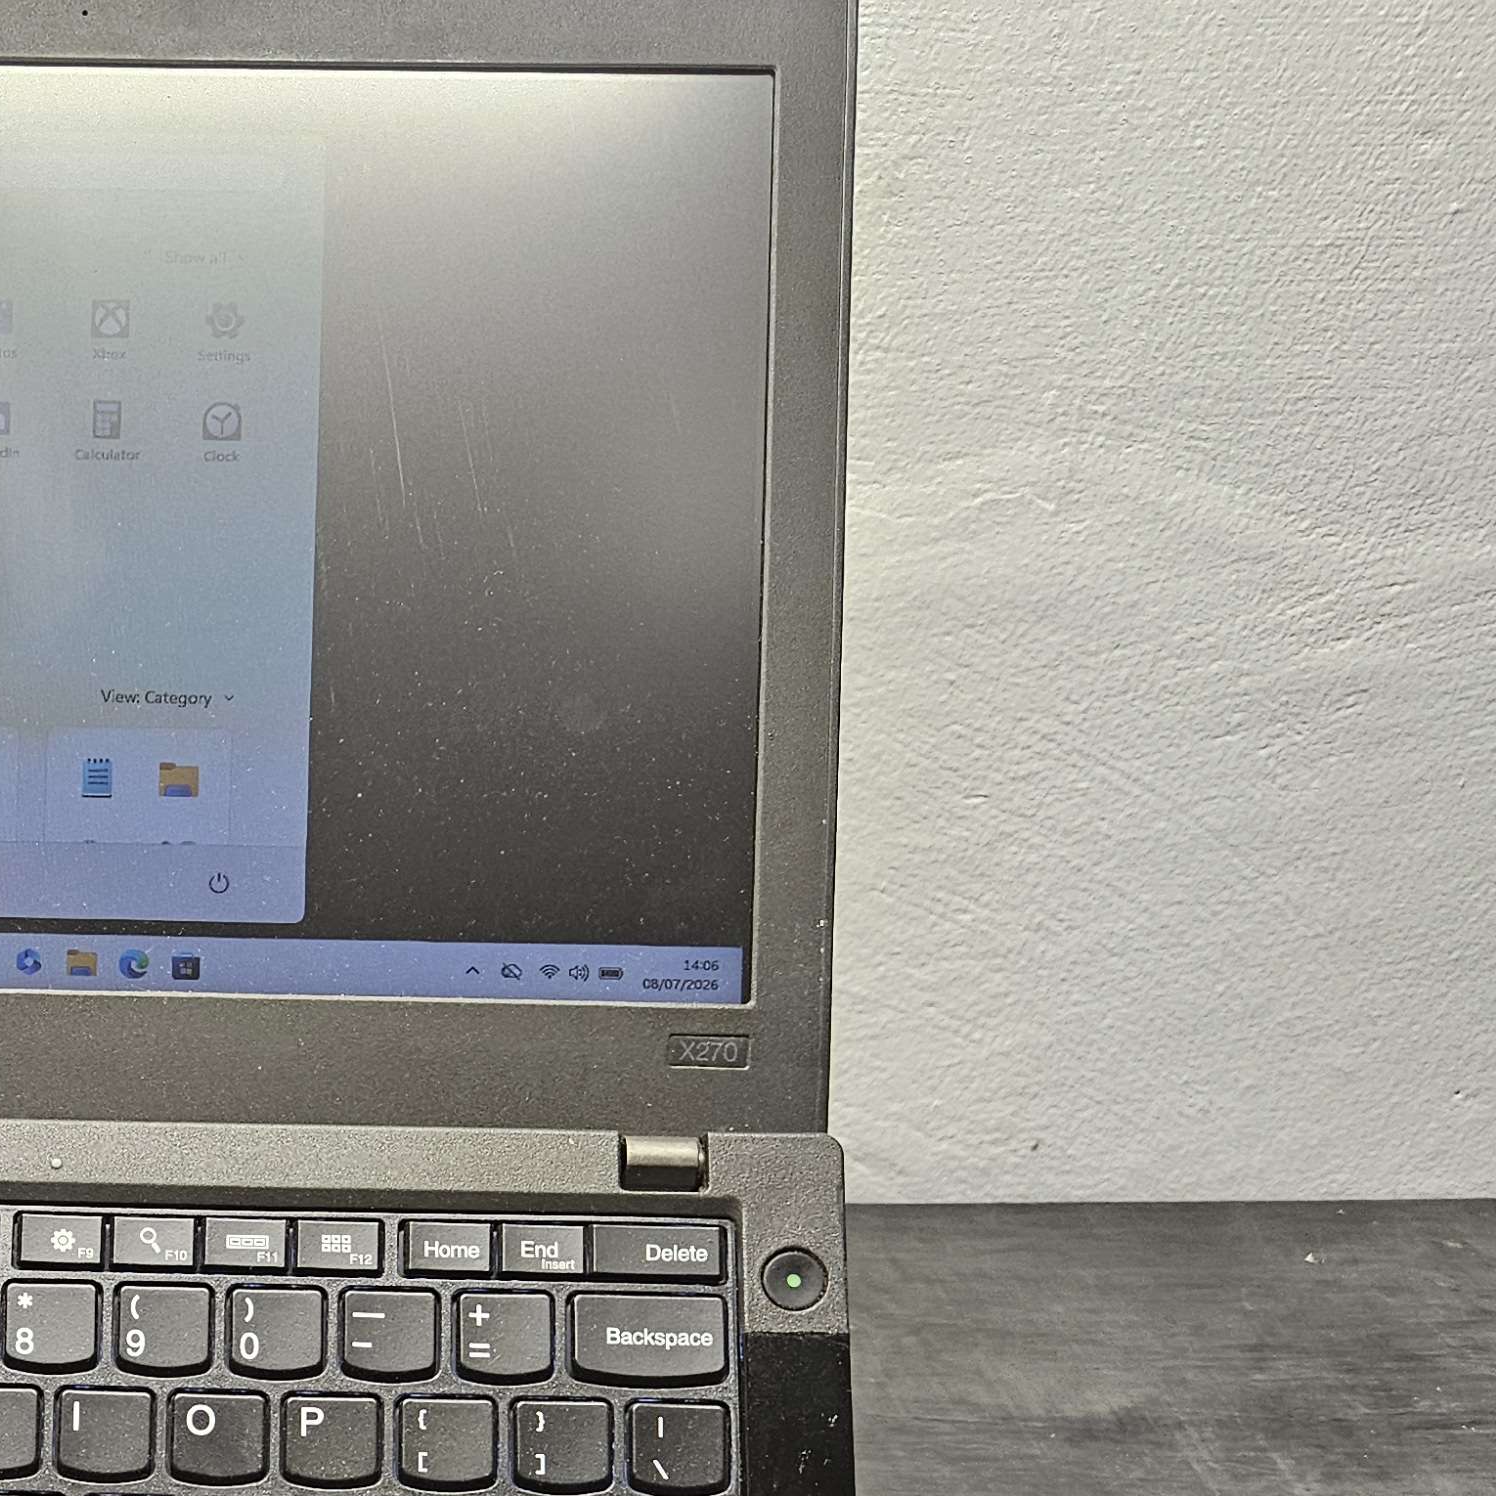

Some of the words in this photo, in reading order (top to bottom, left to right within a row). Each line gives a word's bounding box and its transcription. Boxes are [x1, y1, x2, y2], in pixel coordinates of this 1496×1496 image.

[164, 250, 206, 265] Show
[197, 349, 252, 365] Settings
[74, 448, 142, 461] Calculator
[203, 450, 240, 463] Clock
[100, 688, 141, 705] View:
[144, 690, 213, 709] Category
[683, 959, 720, 972] 14:06
[642, 977, 720, 992] 08/07/2026
[677, 1039, 739, 1063] X270
[77, 1247, 94, 1259] F9
[164, 1249, 188, 1261] F10
[256, 1251, 278, 1264] F11
[349, 1253, 373, 1265] F12
[424, 1240, 481, 1259] Home
[520, 1240, 559, 1259] End
[645, 1243, 709, 1263] Delete
[541, 1258, 576, 1271] Insert
[15, 1327, 35, 1355] 8
[125, 1329, 146, 1358] 9
[239, 1332, 260, 1360] 0
[606, 1326, 714, 1352] Backspace
[72, 1400, 80, 1432] I
[186, 1403, 216, 1436] O
[300, 1406, 325, 1437] P
